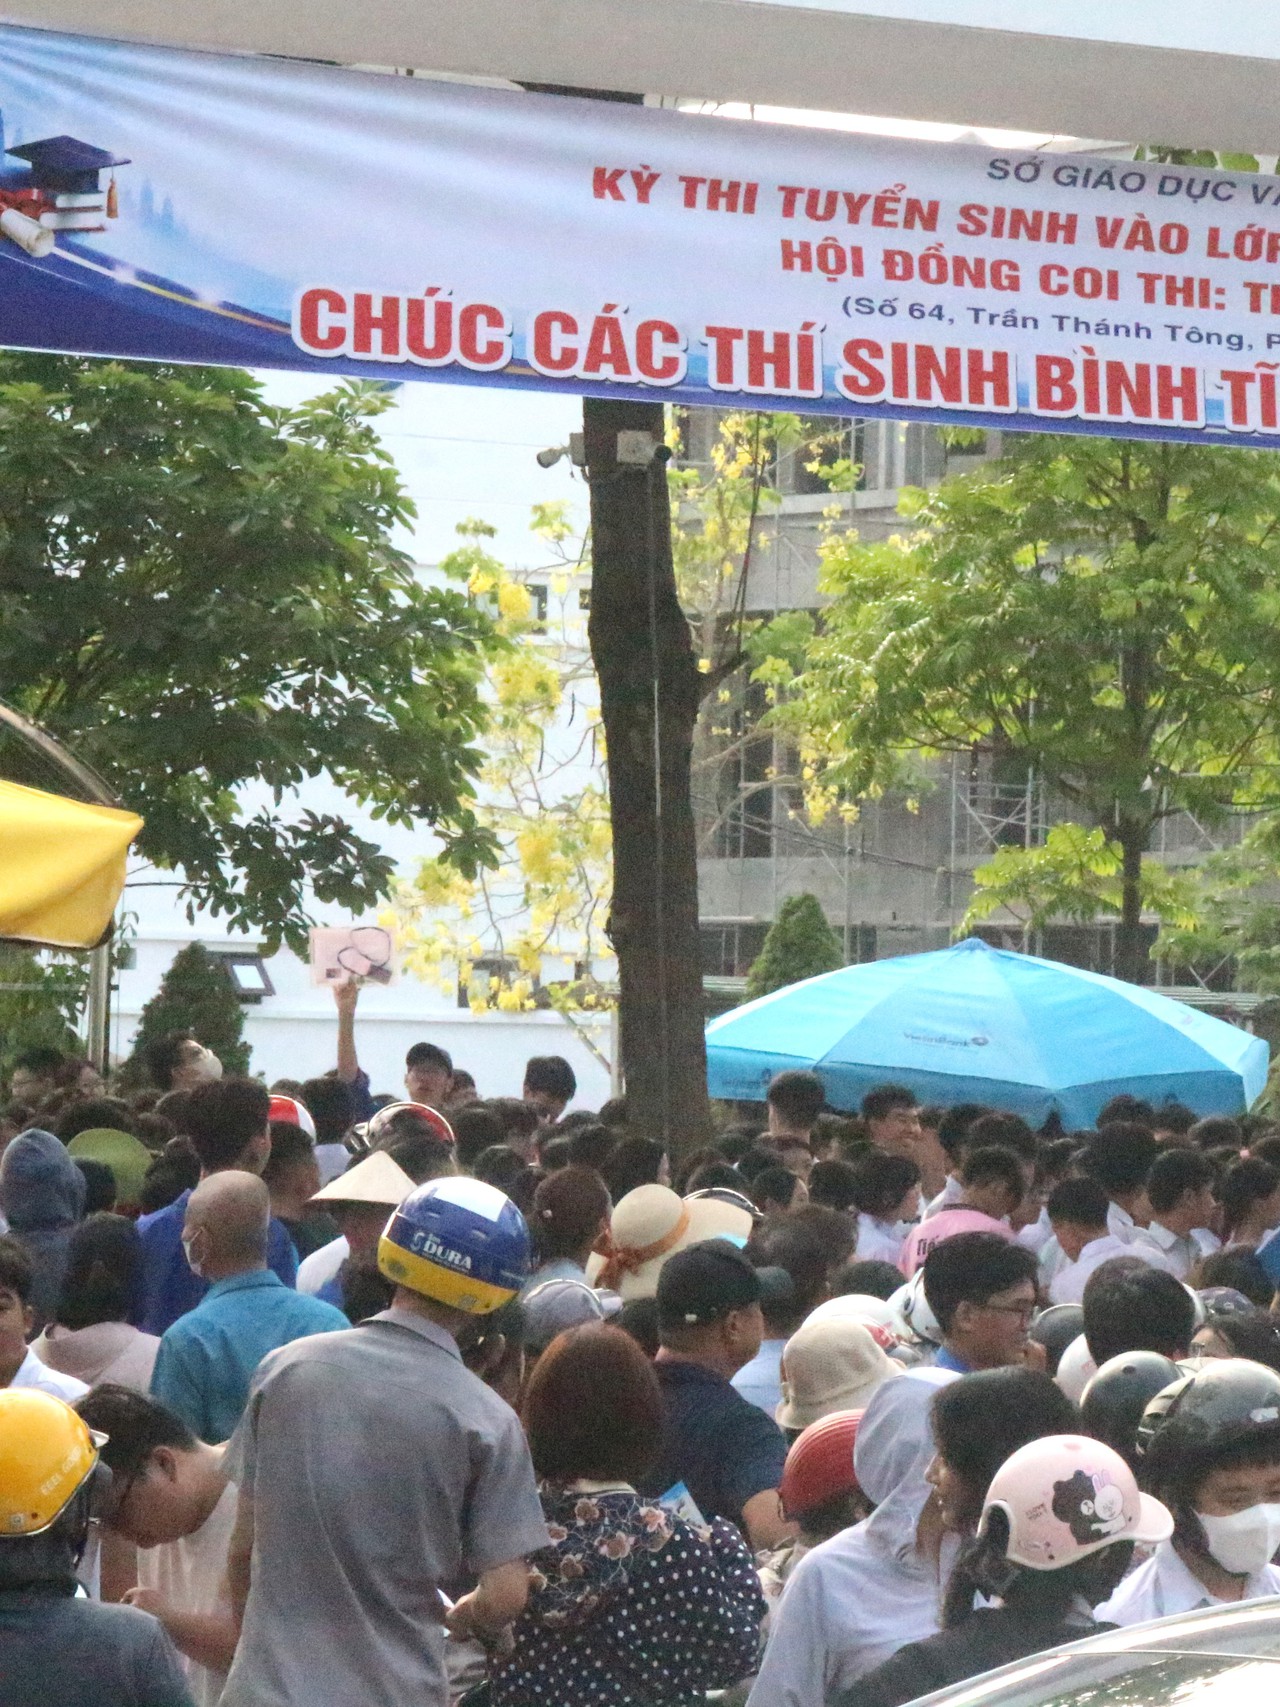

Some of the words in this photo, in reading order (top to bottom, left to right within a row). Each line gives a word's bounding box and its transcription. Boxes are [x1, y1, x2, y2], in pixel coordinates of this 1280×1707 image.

[679, 175, 759, 214] THI
[778, 183, 940, 232] TUYỂN
[957, 204, 1078, 245] SINH
[1096, 212, 1189, 255] VÀO
[1053, 164, 1147, 193] GIÁO
[1158, 175, 1237, 203] DỤC
[781, 236, 864, 282] HỘI
[882, 242, 1021, 292] ĐỒNG
[1039, 263, 1119, 301] COI
[1137, 272, 1225, 310] THI:
[300, 286, 505, 365] CHÚC
[533, 303, 680, 380] CÁC
[705, 321, 816, 391] THÍ
[842, 338, 1011, 406] SINH
[1035, 345, 1199, 422] BÌNH
[842, 296, 898, 318] (Số
[908, 302, 954, 325] 64,
[966, 306, 1039, 330] Trần
[1051, 313, 1152, 340] Thánh
[1164, 325, 1254, 351] Tông,
[423, 1240, 472, 1270] DURA
